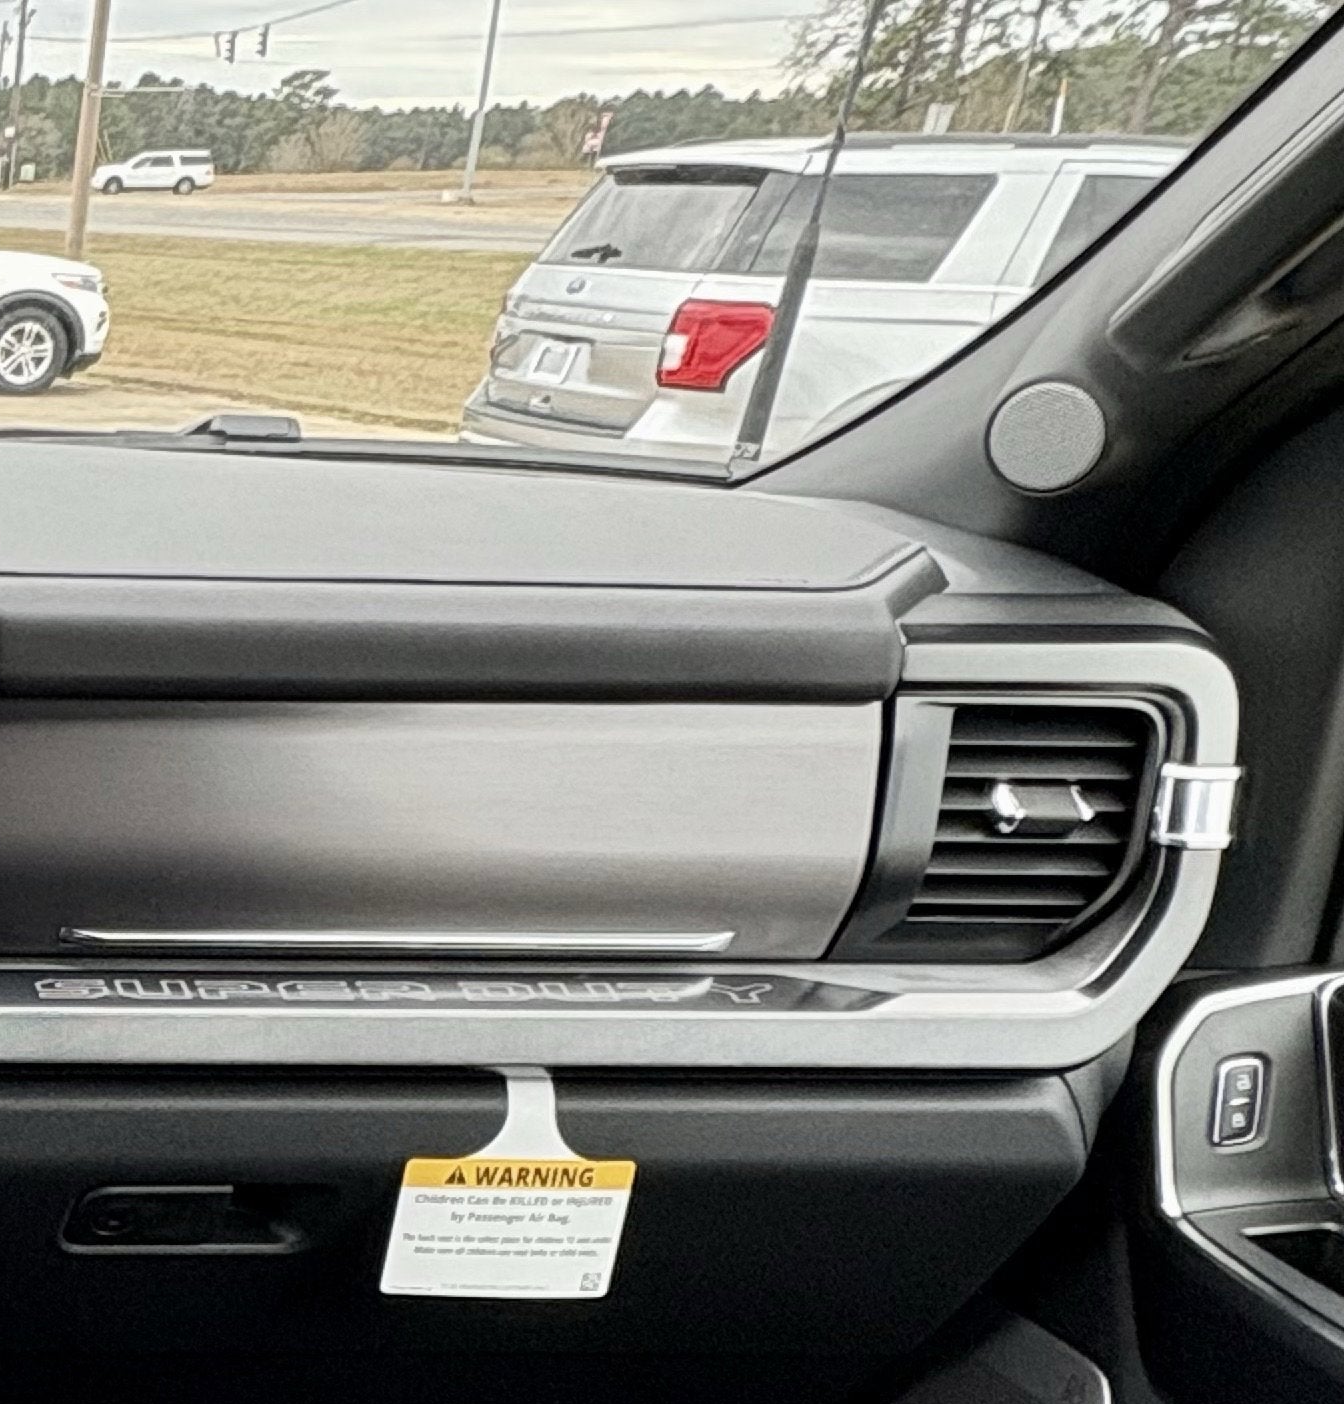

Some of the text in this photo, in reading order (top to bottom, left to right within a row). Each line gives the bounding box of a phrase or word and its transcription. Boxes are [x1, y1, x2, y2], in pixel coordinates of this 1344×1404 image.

[34, 977, 773, 1003] SUPER DUTY
[476, 1167, 595, 1187] WARNING
[414, 1194, 464, 1205] Children
[450, 1211, 466, 1224] by
[468, 1212, 526, 1225] Passenger
[528, 1212, 545, 1223] Air
